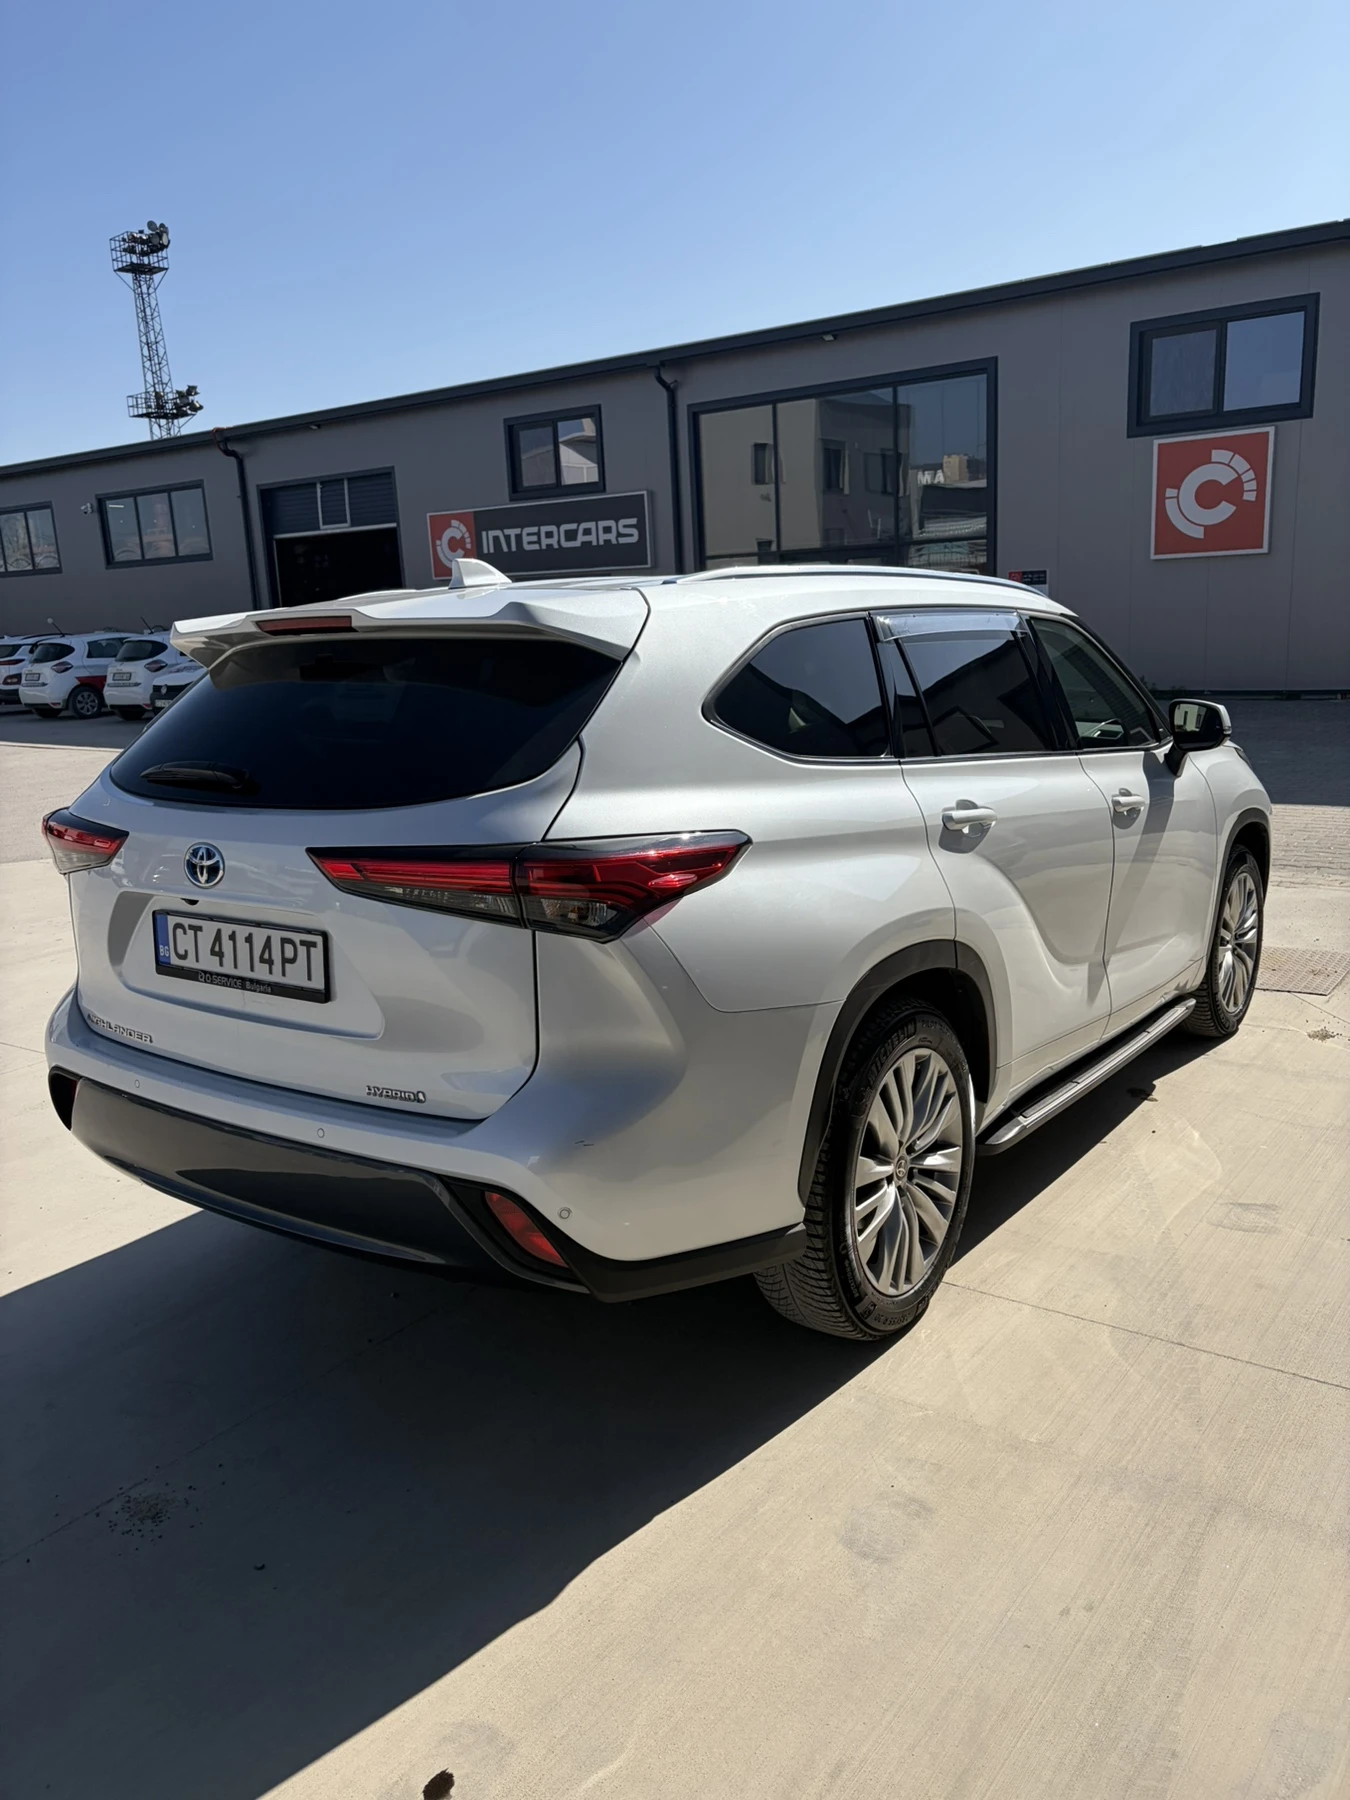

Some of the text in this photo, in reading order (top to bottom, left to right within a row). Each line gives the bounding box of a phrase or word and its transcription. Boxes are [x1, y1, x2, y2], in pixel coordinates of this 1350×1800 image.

[481, 518, 639, 554] INTERCARS
[159, 945, 170, 957] BG
[212, 975, 242, 989] SERVICE
